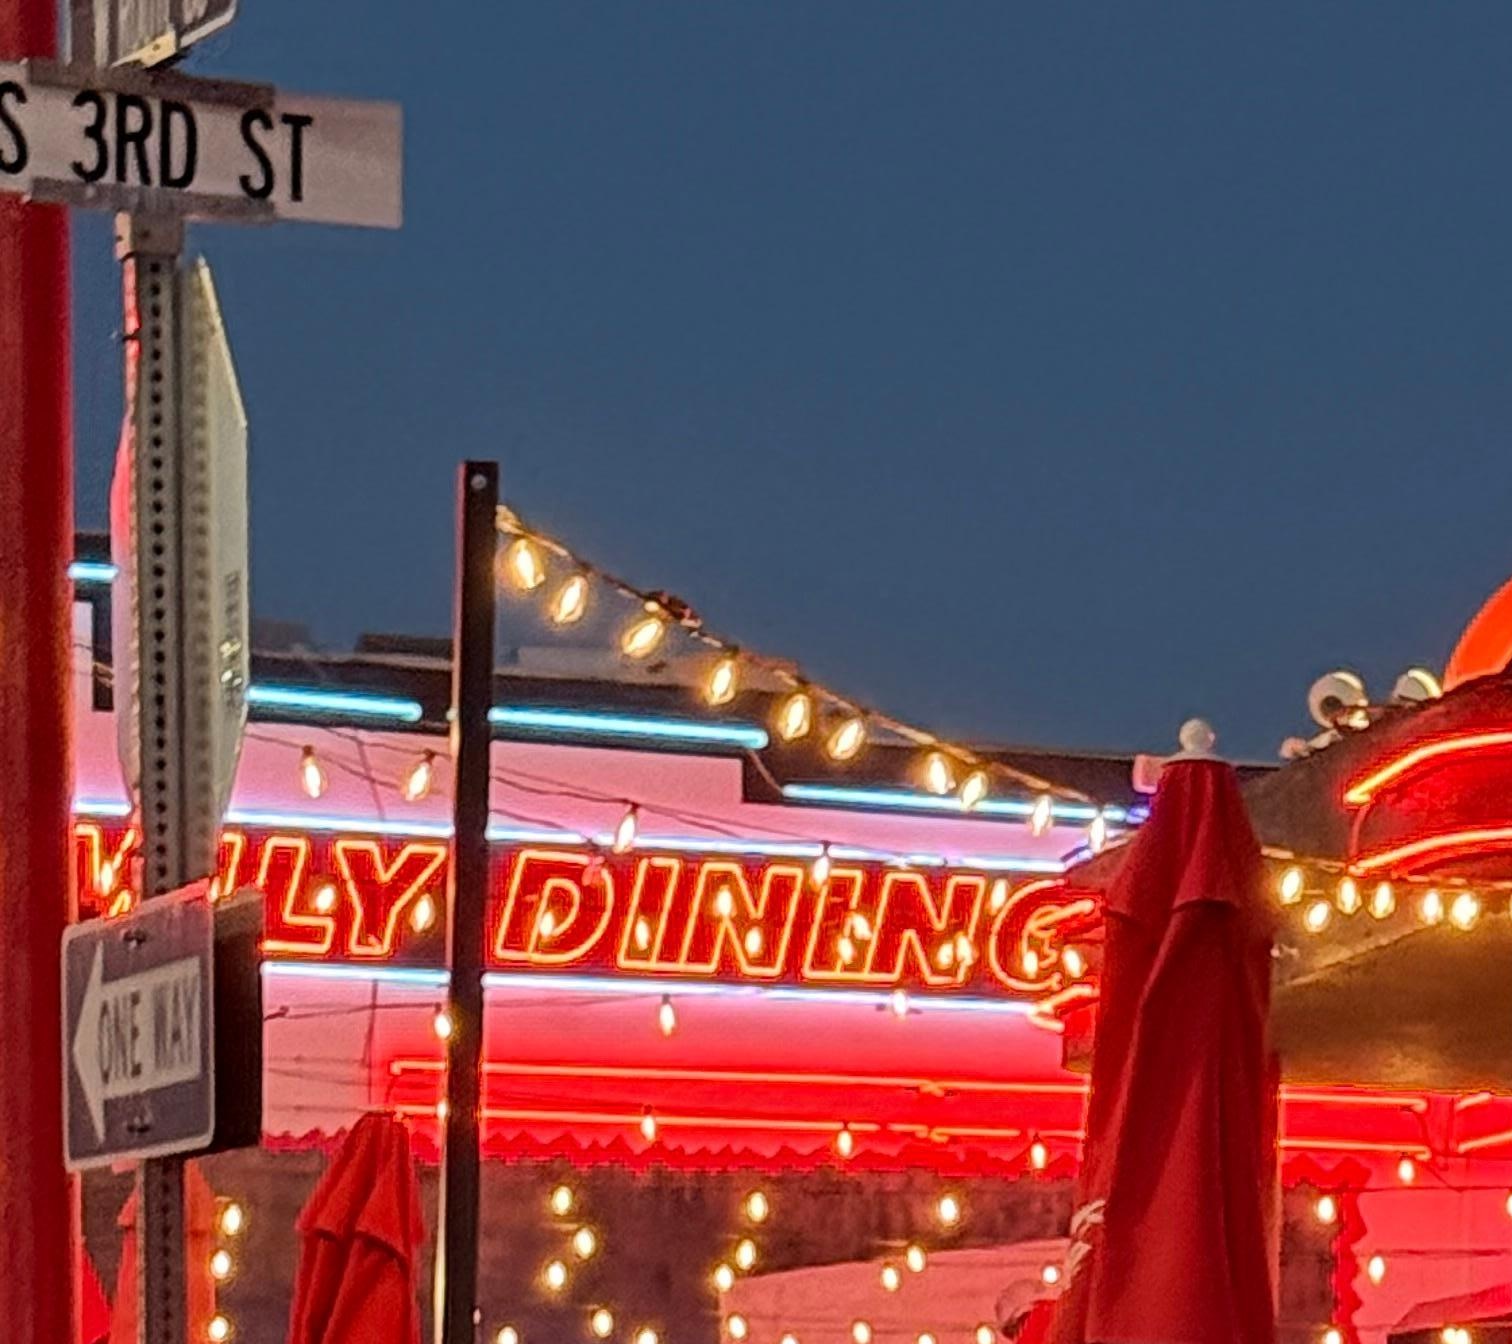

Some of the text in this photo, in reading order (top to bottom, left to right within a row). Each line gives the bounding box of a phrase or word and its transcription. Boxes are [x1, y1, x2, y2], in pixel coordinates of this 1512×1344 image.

[0, 80, 314, 202] S 3RD ST
[494, 846, 1100, 993] DINING
[99, 973, 200, 1085] ONE WAY
